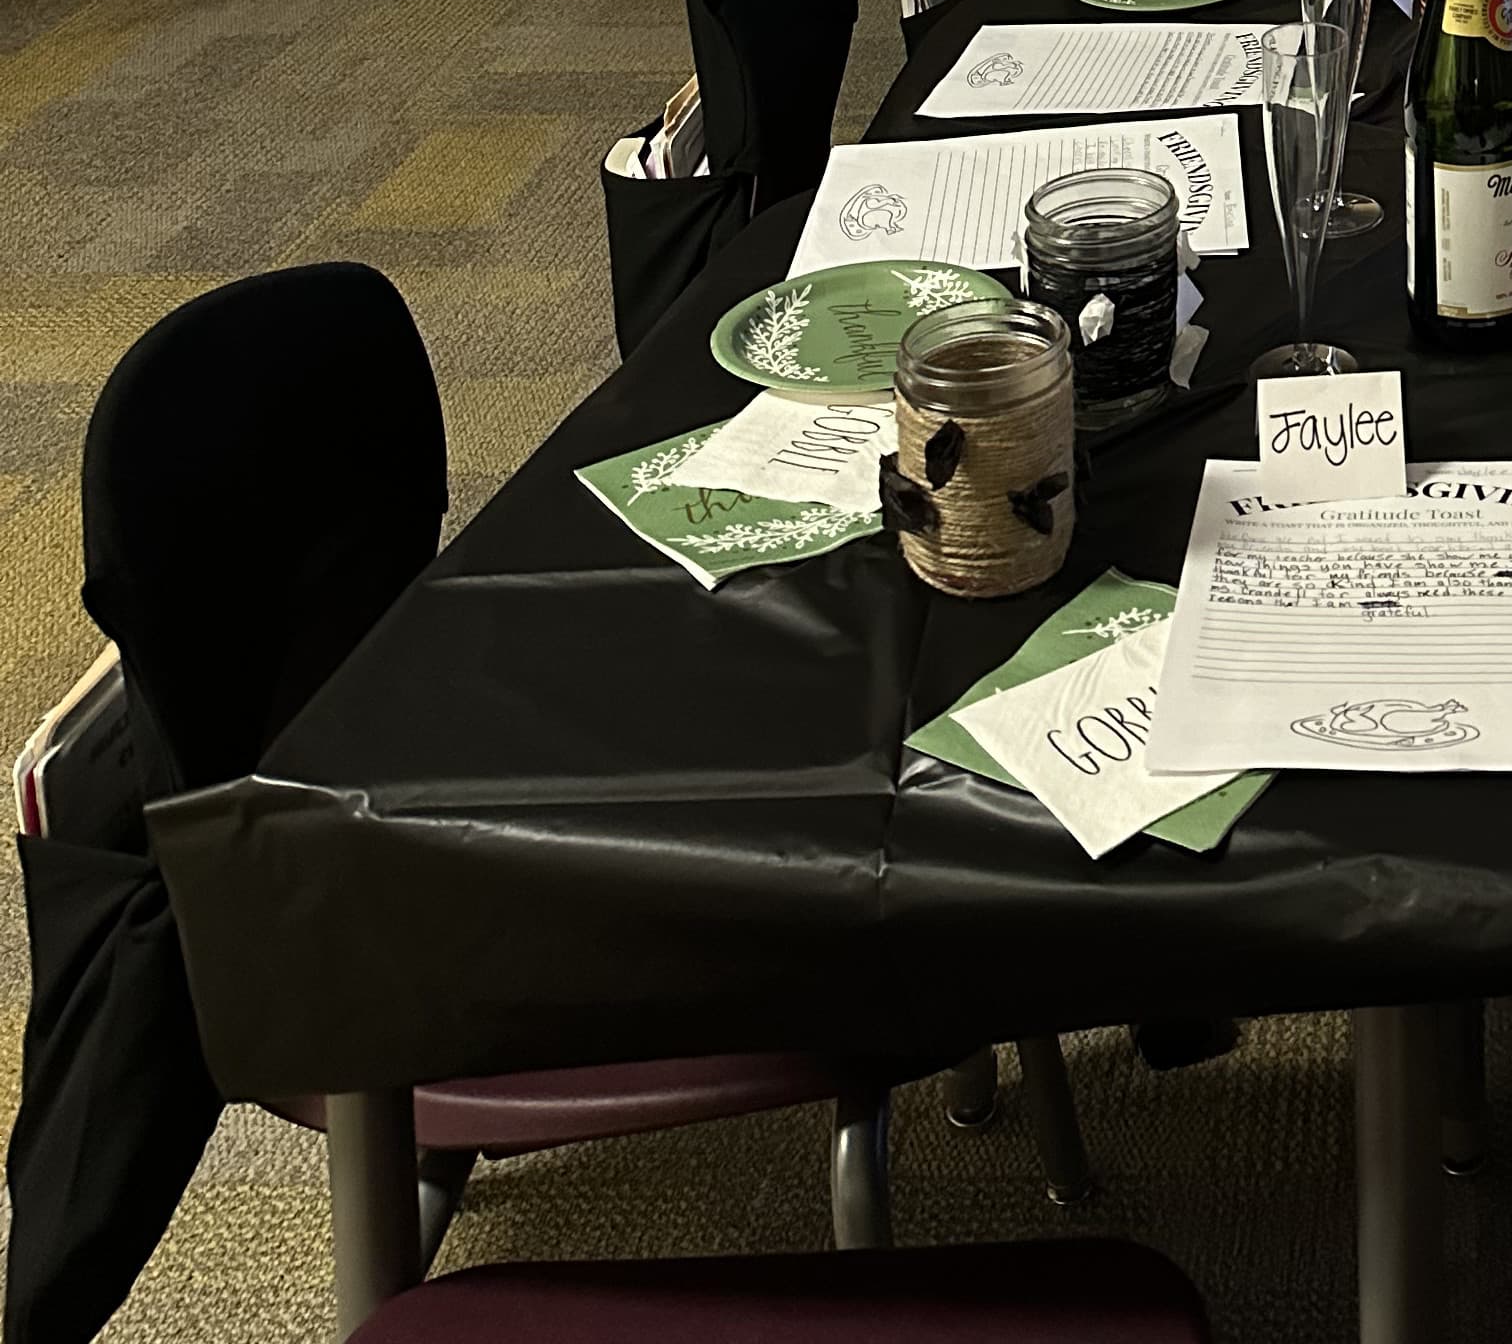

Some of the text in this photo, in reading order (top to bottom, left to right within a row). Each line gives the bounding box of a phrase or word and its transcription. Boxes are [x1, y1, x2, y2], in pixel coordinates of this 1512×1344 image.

[1157, 131, 1213, 234] FRIENDSGIVIN
[768, 404, 895, 474] GOBBLE
[1269, 403, 1397, 466] Jaylee
[1225, 519, 1256, 528] WRITE
[1320, 509, 1484, 521] Gratitude Toast
[1047, 686, 1157, 775] GOBB
